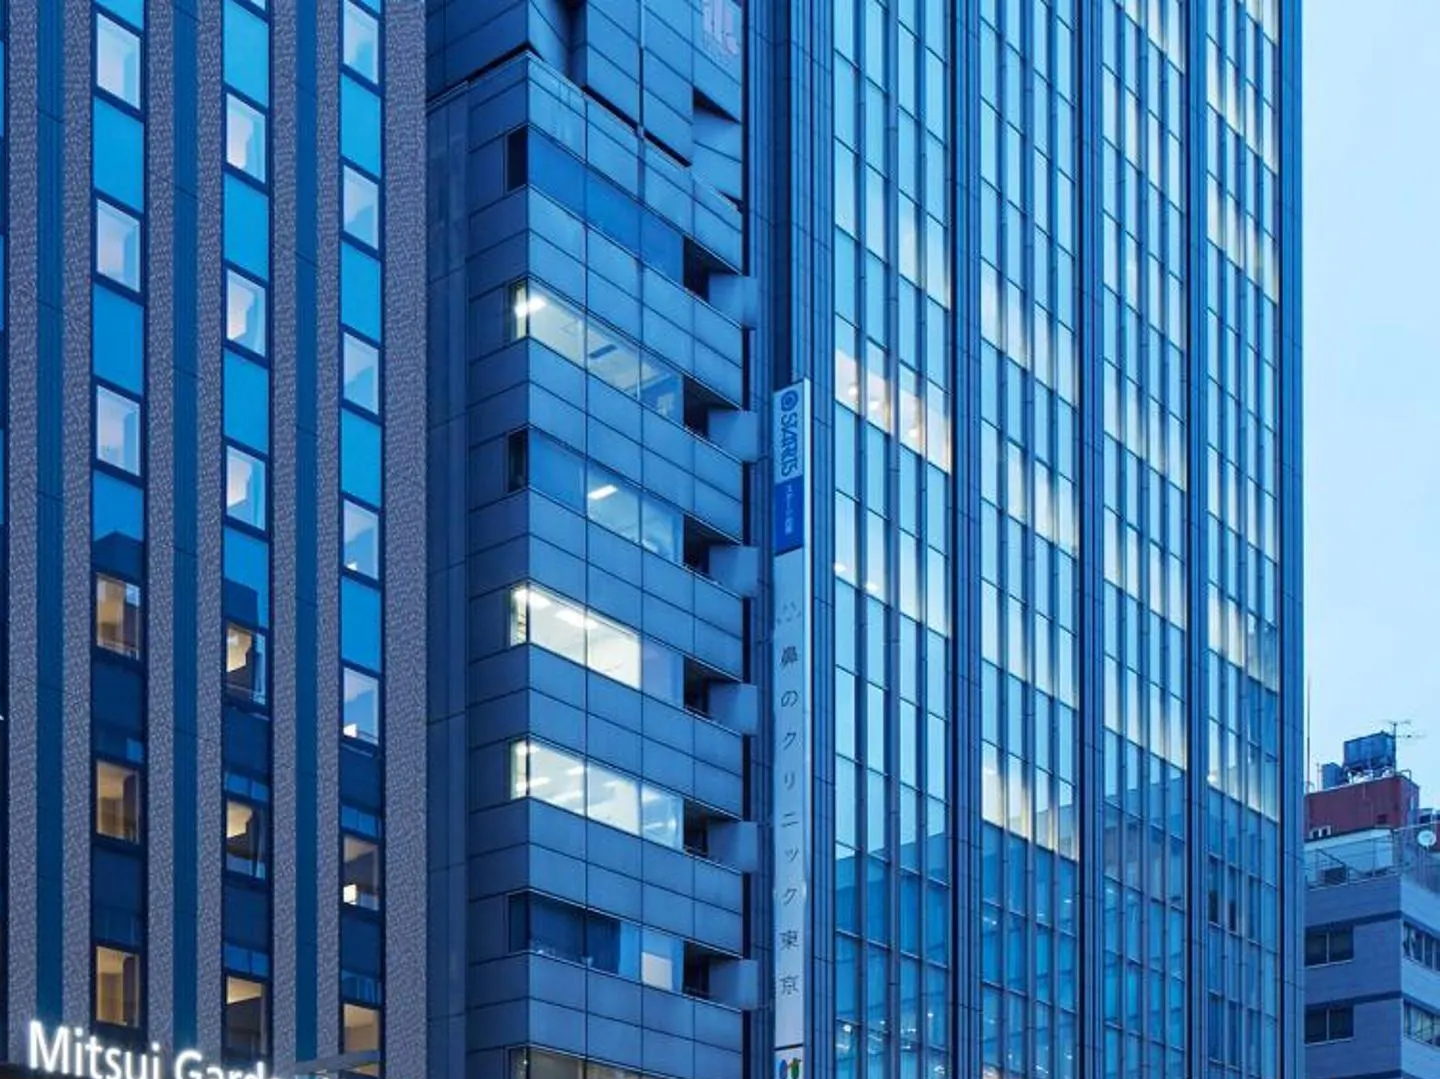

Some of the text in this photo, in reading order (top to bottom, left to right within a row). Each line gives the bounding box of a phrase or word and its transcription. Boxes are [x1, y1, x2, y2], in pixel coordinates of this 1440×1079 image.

[780, 645, 799, 995] 鼻のクリニック東京
